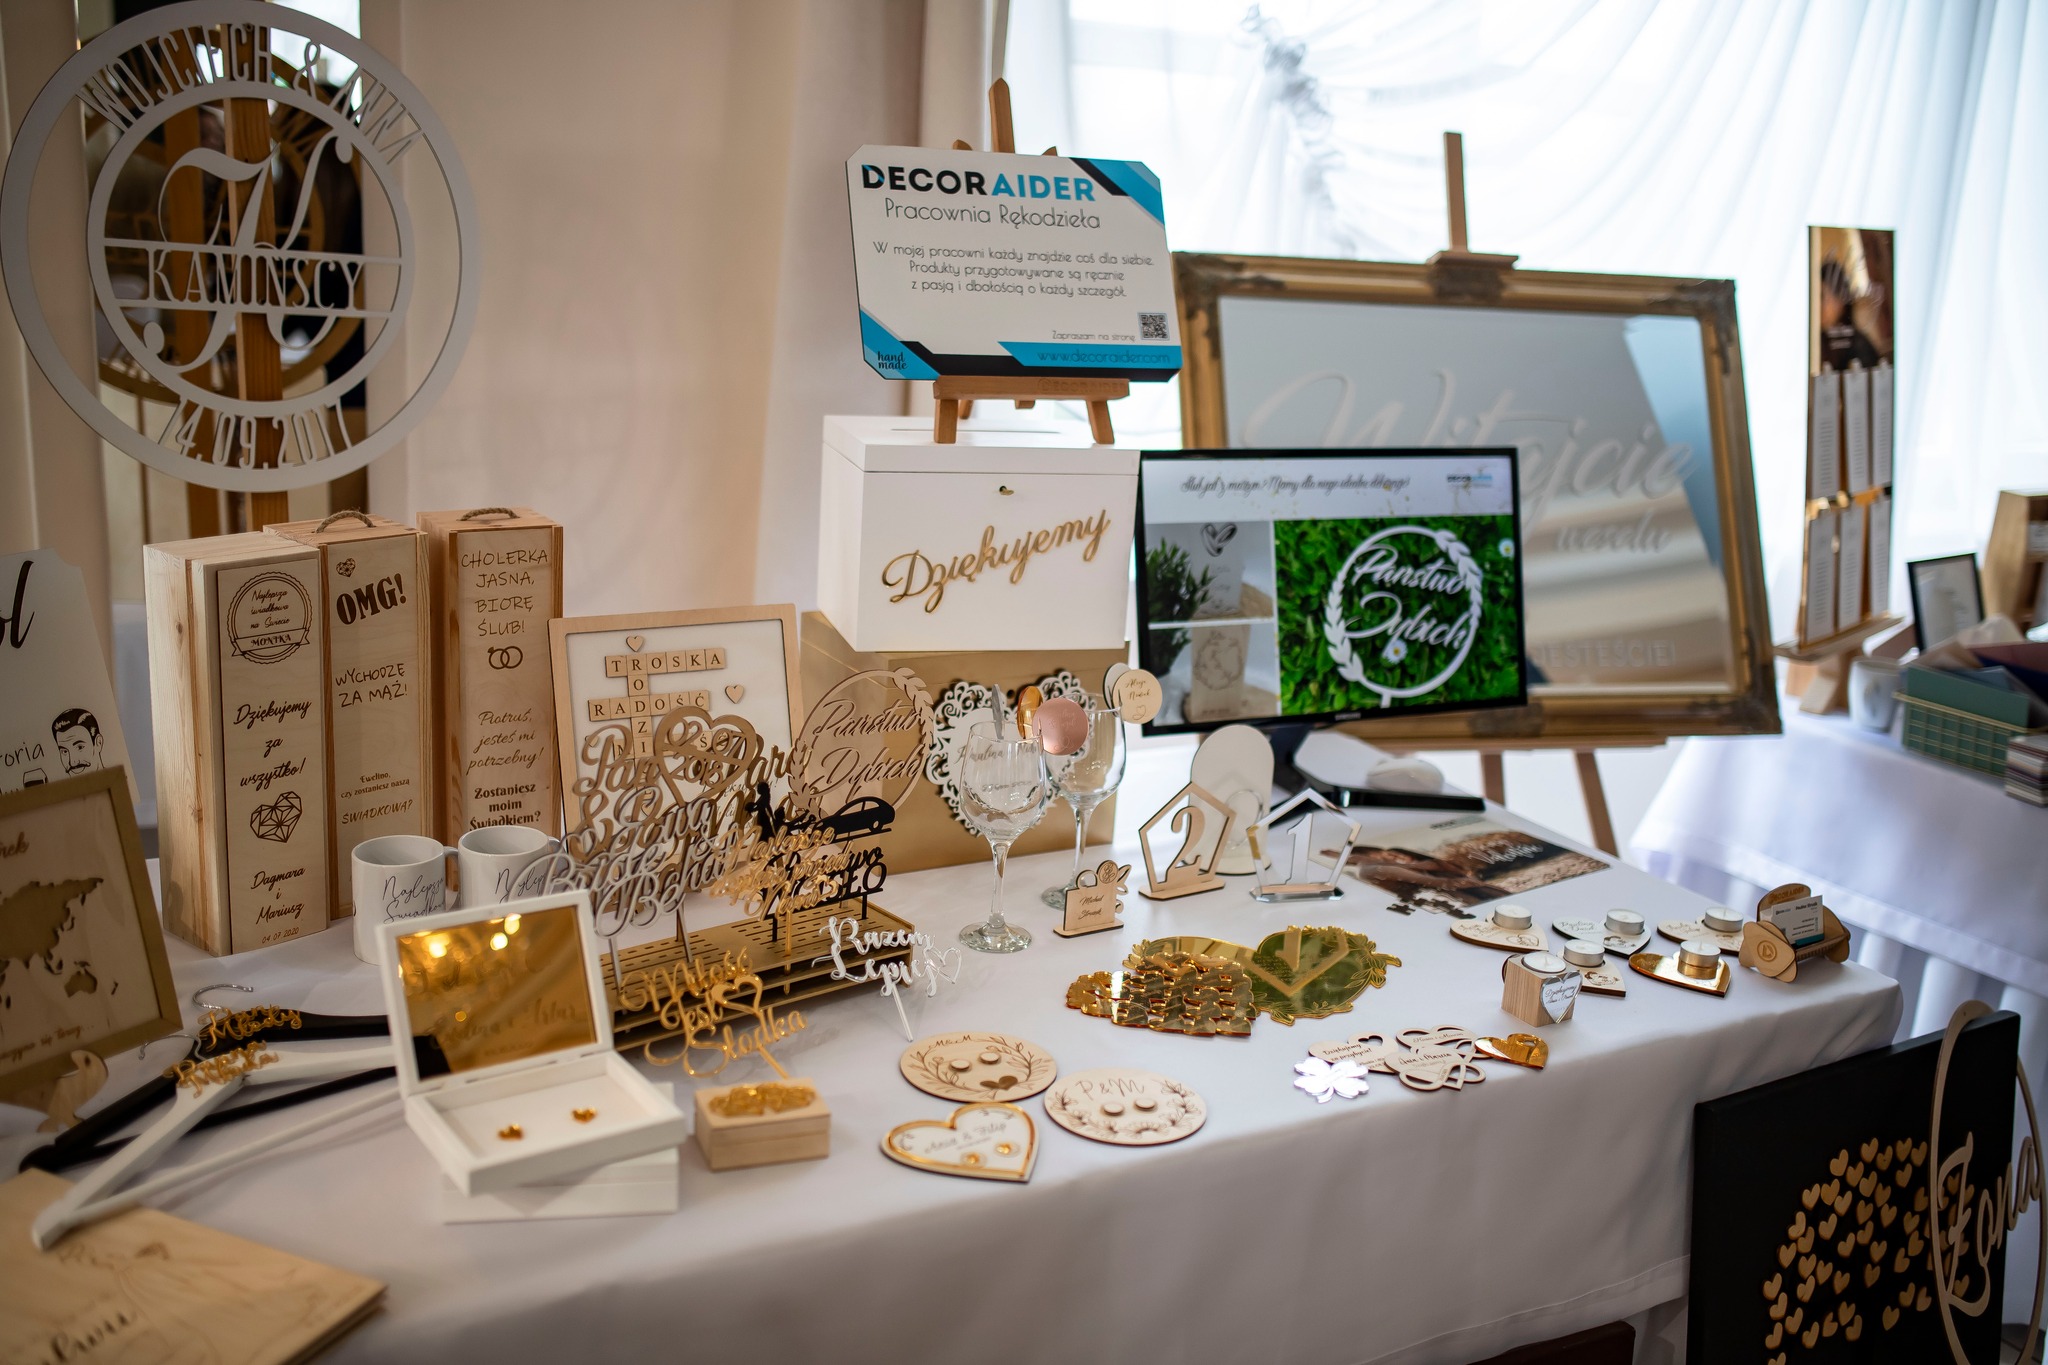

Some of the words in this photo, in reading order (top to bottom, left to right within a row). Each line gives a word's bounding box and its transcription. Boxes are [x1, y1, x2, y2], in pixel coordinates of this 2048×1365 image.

[861, 164, 1096, 201] DECORAIDER
[885, 198, 991, 223] Pracownia
[1000, 204, 1100, 229] Rękodzieła
[873, 241, 888, 253] W
[893, 245, 925, 258] mojej
[929, 247, 985, 260] pracowni
[988, 249, 1023, 263] każdy
[1027, 251, 1072, 265] znajdzie
[1076, 252, 1096, 264] coś
[1100, 252, 1118, 265] dla
[909, 259, 960, 276] Produkty
[964, 264, 1064, 280] przygotowywane
[1068, 270, 1081, 281] są
[1085, 270, 1125, 281] ręcznie
[911, 280, 917, 289] z
[922, 279, 954, 293] pasją
[1028, 285, 1036, 294] o
[1040, 282, 1074, 298] każdy
[1098, 333, 1109, 341] na
[877, 350, 905, 361] hand
[878, 359, 908, 370] made
[1037, 350, 1171, 365] www.decoraider.com
[461, 549, 548, 569] CHOLERKA
[882, 509, 1111, 614] Dziękujemy
[476, 571, 535, 588] JASNA,
[336, 573, 407, 625] OMG!
[474, 596, 534, 613] BIORĘ
[478, 618, 525, 637] ŚLUB!
[250, 634, 292, 648] MONIKA
[611, 652, 722, 673] TROSKA
[335, 663, 406, 686] WYCHODZĘ
[338, 690, 363, 708] ZA
[368, 680, 408, 702] MĄŻ!
[233, 700, 312, 730] Dziękujemy
[263, 738, 283, 758] za
[473, 730, 517, 754] jesteś
[519, 730, 535, 741] mi
[466, 746, 544, 776] potrzebny!
[240, 756, 307, 792] wszystko!
[354, 783, 389, 796] zostaniesz
[474, 783, 537, 800] Zostaniesz
[489, 800, 522, 812] moim
[1164, 805, 1207, 882] 2
[250, 867, 306, 892] Dagmara
[276, 888, 282, 900] i
[255, 903, 305, 925] Mariusz
